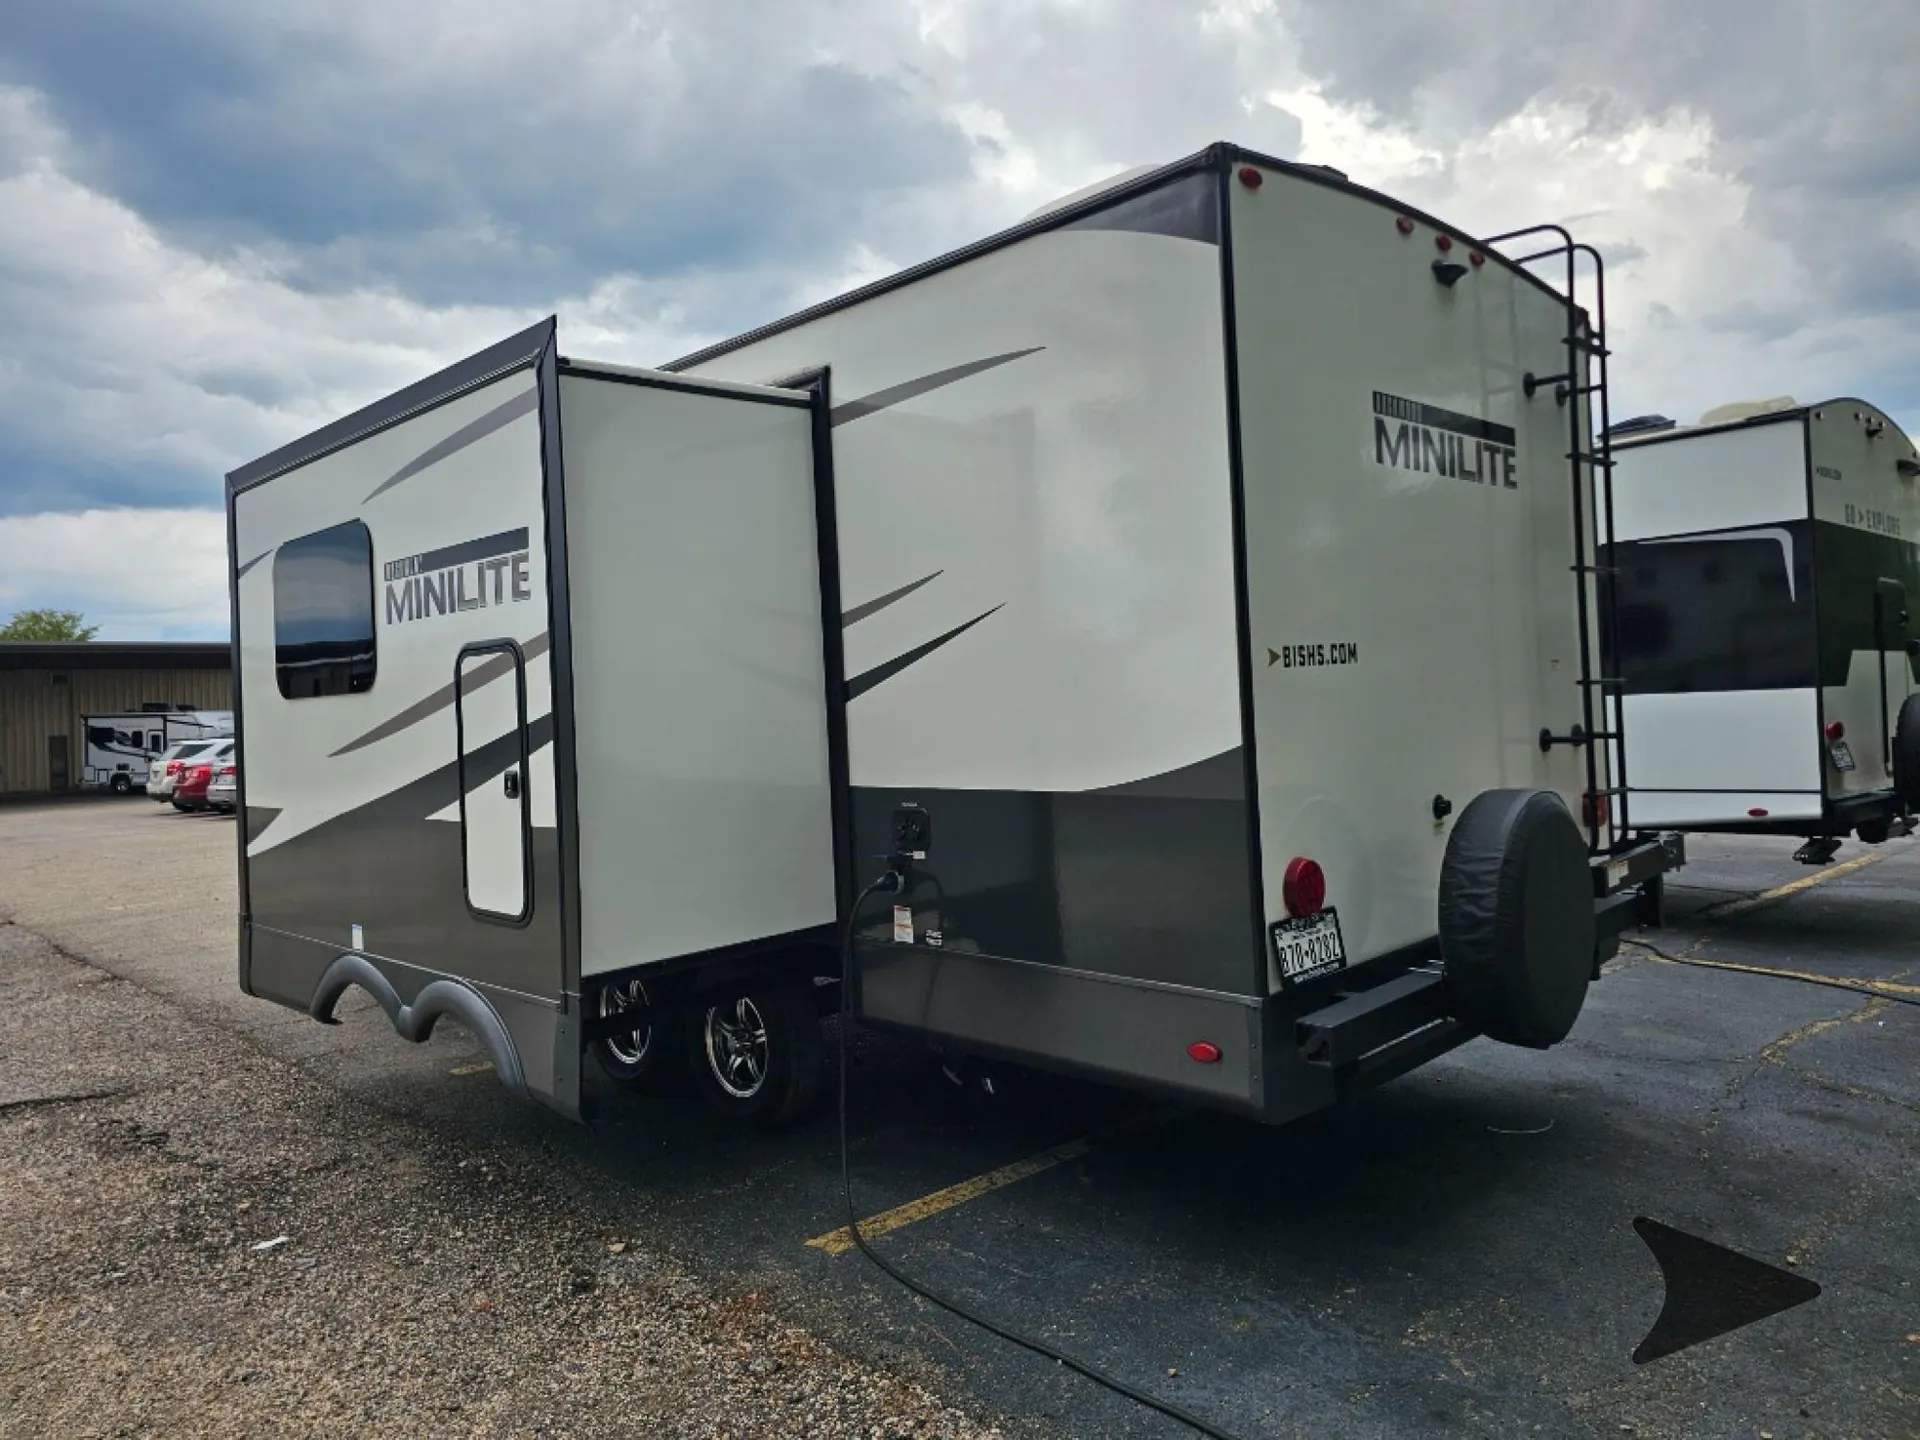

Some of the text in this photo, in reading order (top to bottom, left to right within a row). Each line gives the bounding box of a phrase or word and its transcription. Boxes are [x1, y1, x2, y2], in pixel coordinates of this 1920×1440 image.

[1374, 415, 1518, 490] MINILITE
[385, 551, 532, 626] MINILITE
[1282, 642, 1359, 669] BISHS.COM
